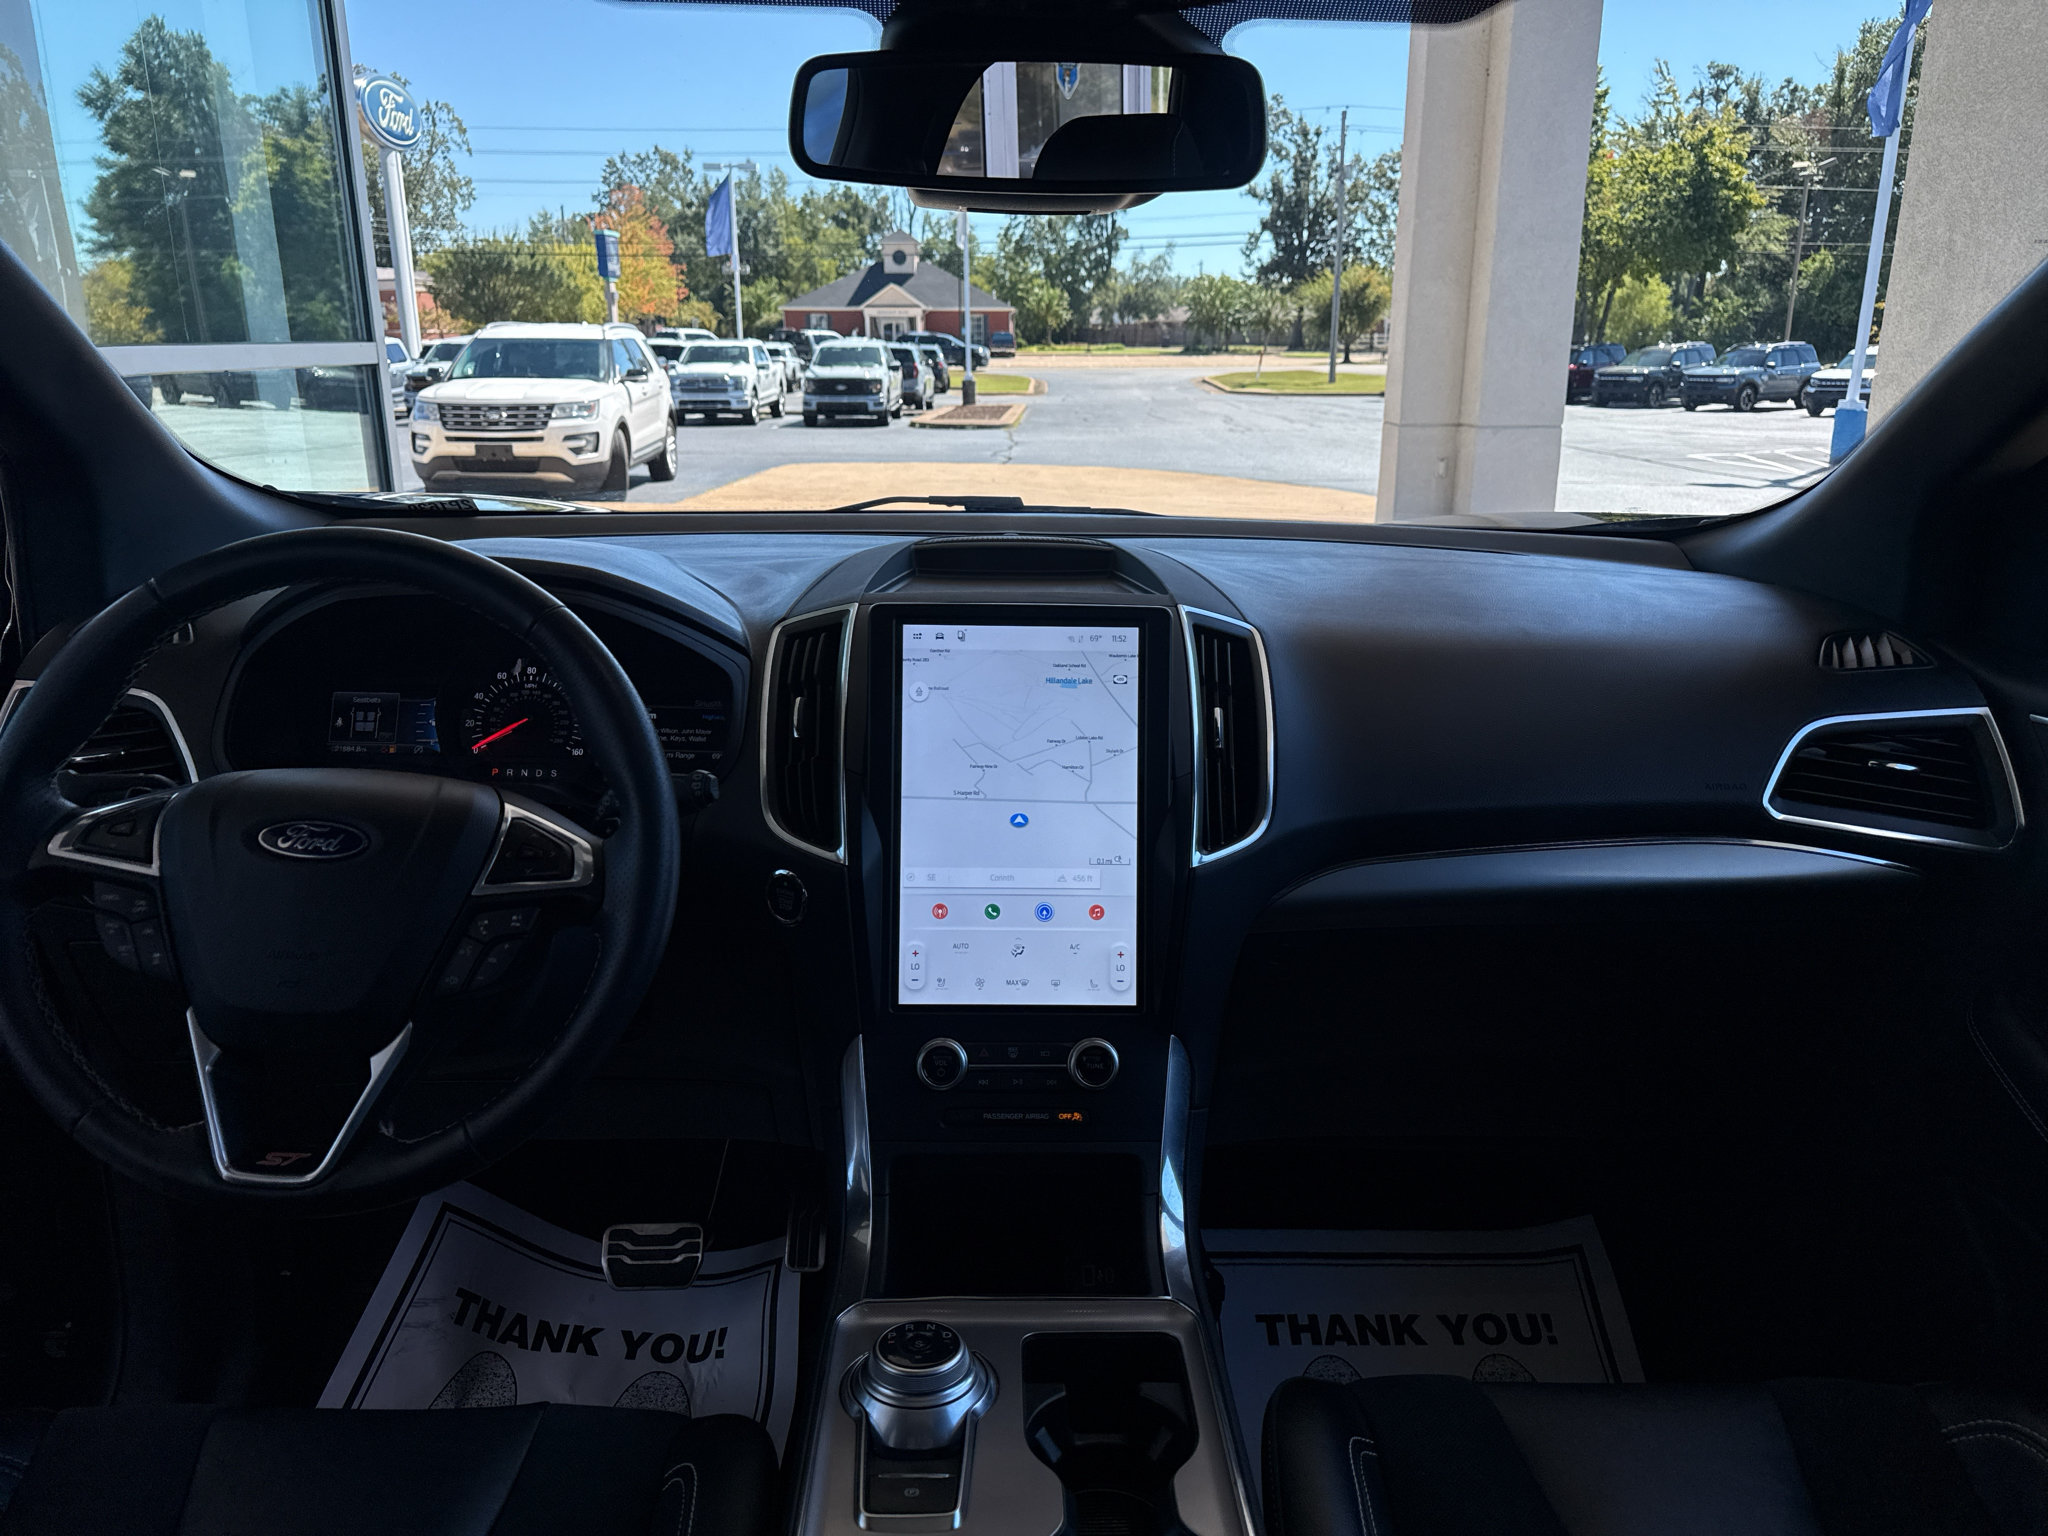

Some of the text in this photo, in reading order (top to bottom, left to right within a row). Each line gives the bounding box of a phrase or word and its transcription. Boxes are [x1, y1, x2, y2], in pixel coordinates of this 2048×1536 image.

[378, 87, 414, 136] Ford
[497, 672, 507, 680] 60
[474, 692, 484, 700] 40
[465, 719, 475, 728] 20
[572, 748, 583, 756] 160
[491, 768, 499, 776] P
[536, 769, 543, 777] D
[550, 769, 557, 777] S
[277, 824, 344, 851] Ford
[927, 873, 936, 881] SE
[990, 873, 1015, 881] Corinth
[1071, 874, 1093, 882] 456 ft
[256, 1152, 312, 1166] ST
[453, 1287, 728, 1364] THANK YOU!
[1256, 1313, 1558, 1346] THANK YOU!
